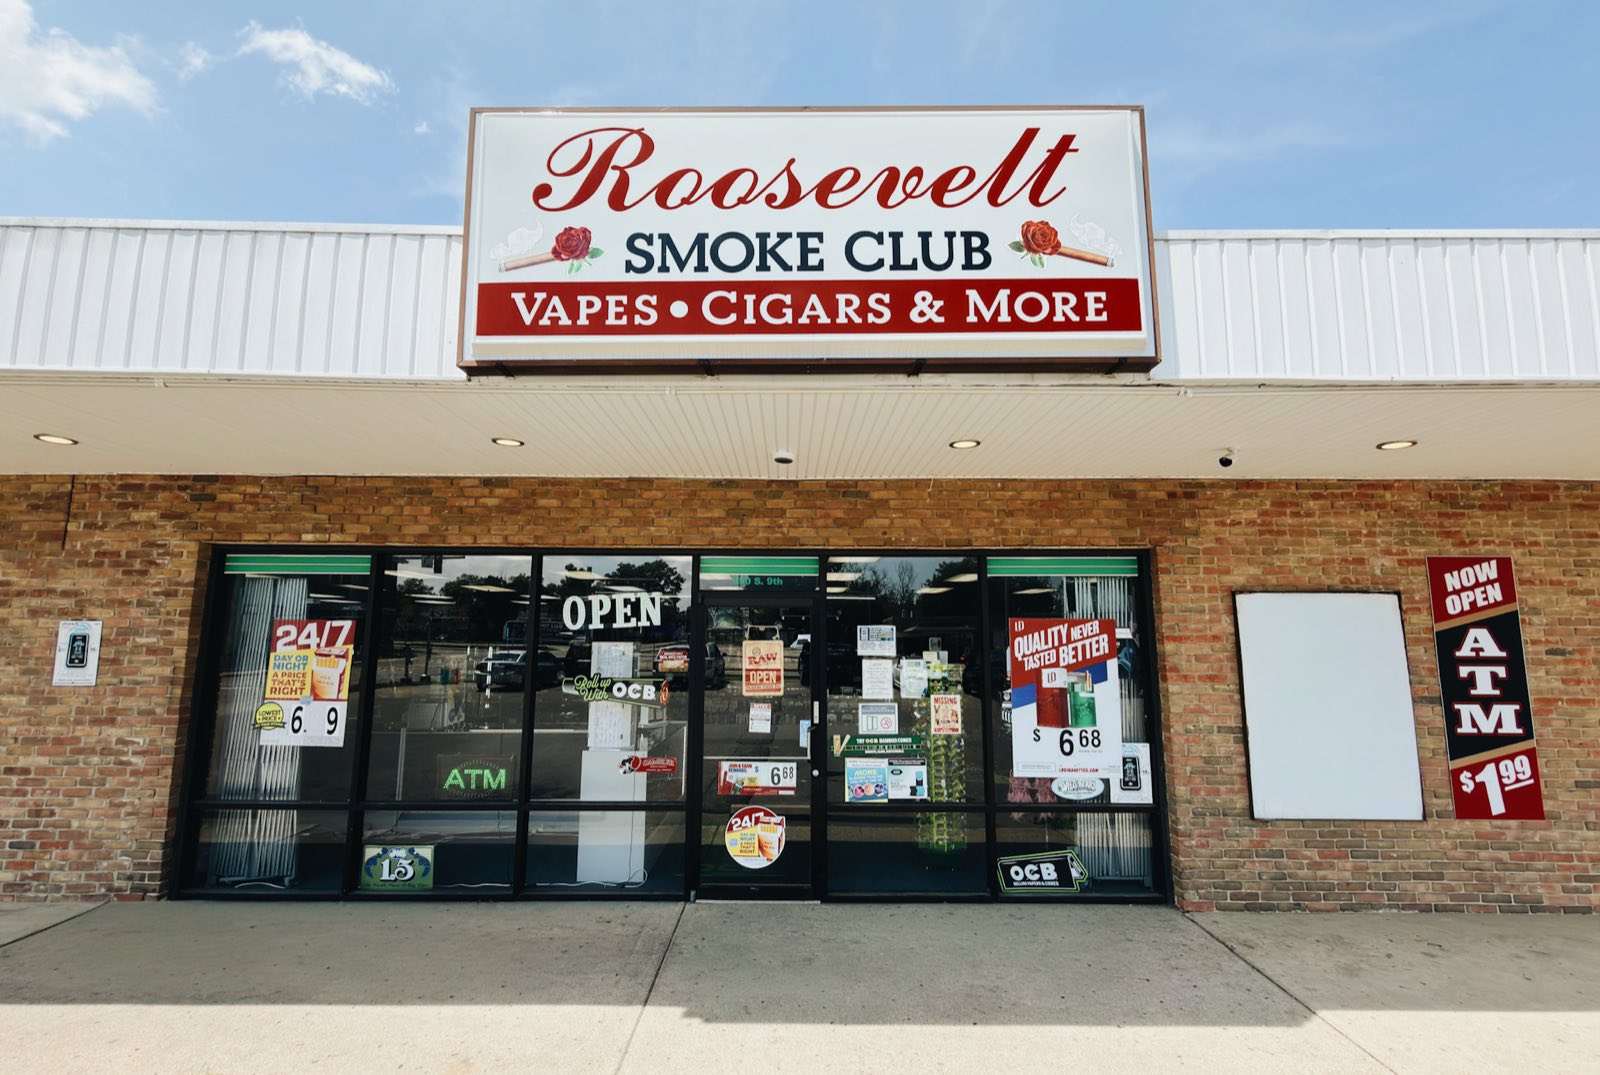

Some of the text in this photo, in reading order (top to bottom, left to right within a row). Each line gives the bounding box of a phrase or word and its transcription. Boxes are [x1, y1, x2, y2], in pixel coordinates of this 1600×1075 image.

[532, 127, 1079, 212] Roosevelt
[624, 230, 993, 274] SMOKE CLUB
[511, 288, 1109, 326] VAPES CIGARS & MORE
[767, 576, 784, 586] 9th
[1444, 559, 1498, 592] NOW
[1445, 582, 1503, 615] OPEN
[562, 591, 662, 631] OPEN
[1014, 620, 1025, 632] LD
[276, 619, 352, 653] 24/7
[1014, 620, 1099, 662] QUALITY NEVER
[273, 654, 294, 662] DAY
[748, 652, 779, 665] RAW
[1023, 633, 1109, 671] TASTED BETTER
[272, 662, 308, 671] NIGHT
[271, 679, 306, 687] THAT'S
[574, 673, 612, 690] Roll up
[750, 670, 776, 684] OPEN
[1454, 628, 1523, 734] ATM
[270, 687, 306, 695] RIGHT
[580, 687, 609, 701] With
[612, 682, 656, 700] OCB
[933, 696, 958, 705] MISSING
[258, 709, 281, 717] LOWEST
[327, 706, 338, 735] 9
[1033, 728, 1041, 742] $
[443, 768, 507, 790] ATM
[731, 811, 764, 831] 24/7
[379, 858, 415, 881] 1.5
[1010, 862, 1058, 881] OCB
